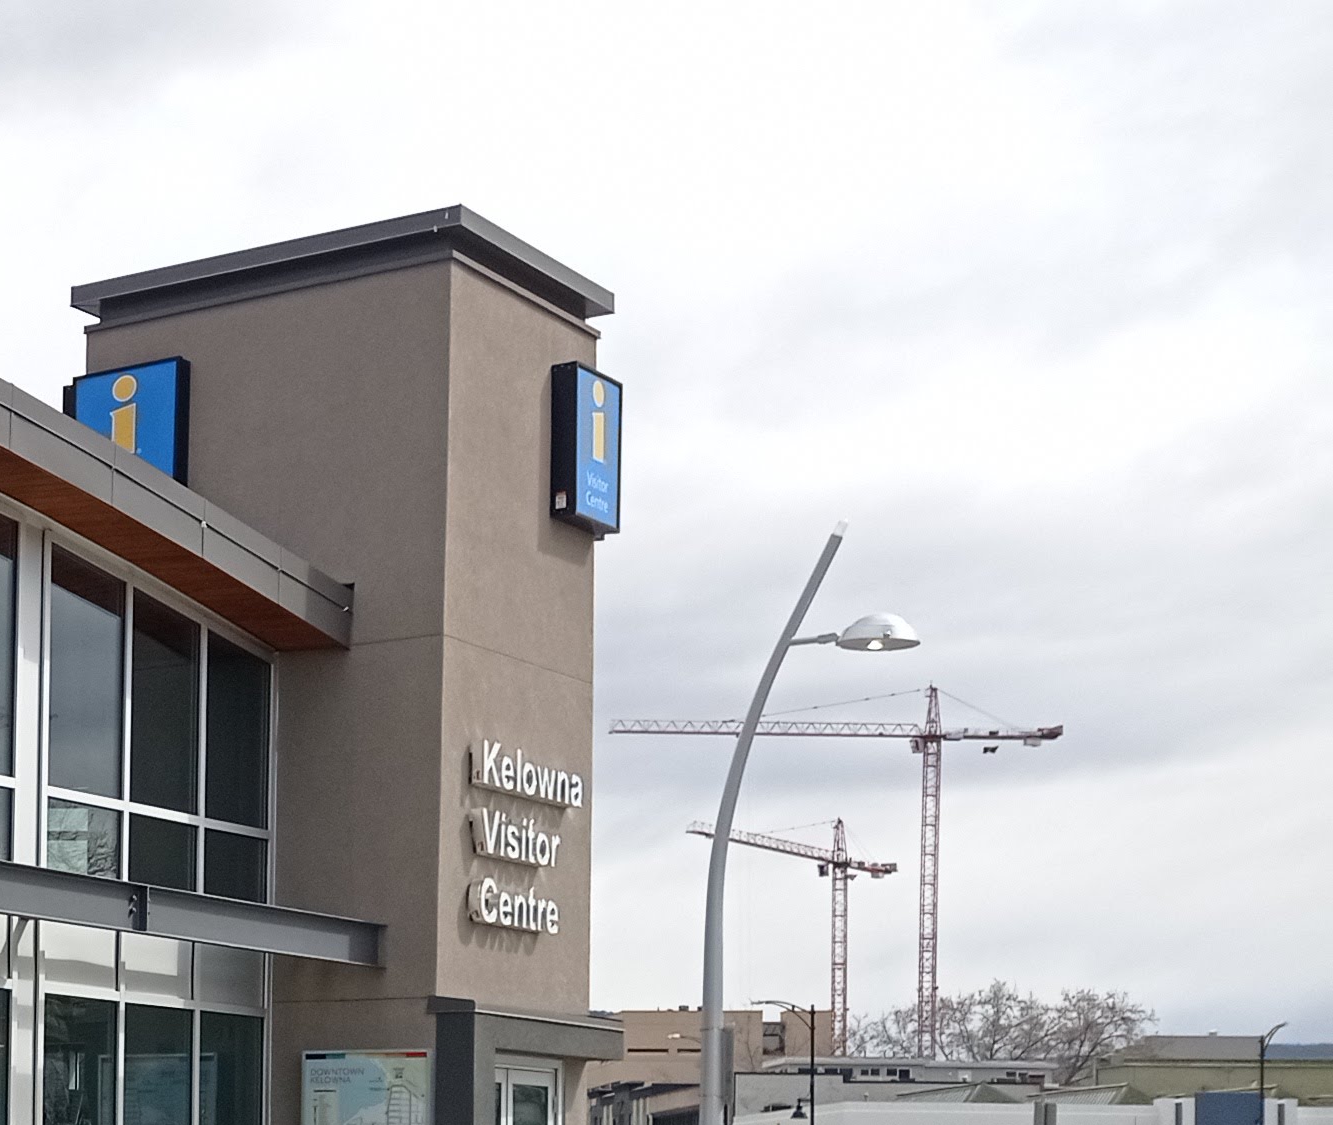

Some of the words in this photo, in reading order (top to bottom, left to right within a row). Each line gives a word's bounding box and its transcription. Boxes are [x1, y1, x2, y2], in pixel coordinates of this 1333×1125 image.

[586, 490, 609, 514] Centre
[587, 470, 609, 493] Visitor
[483, 739, 583, 808] Kelowna
[483, 807, 561, 868] Visitor
[480, 877, 560, 935] Centre
[311, 1068, 365, 1076] DOWNTOWN
